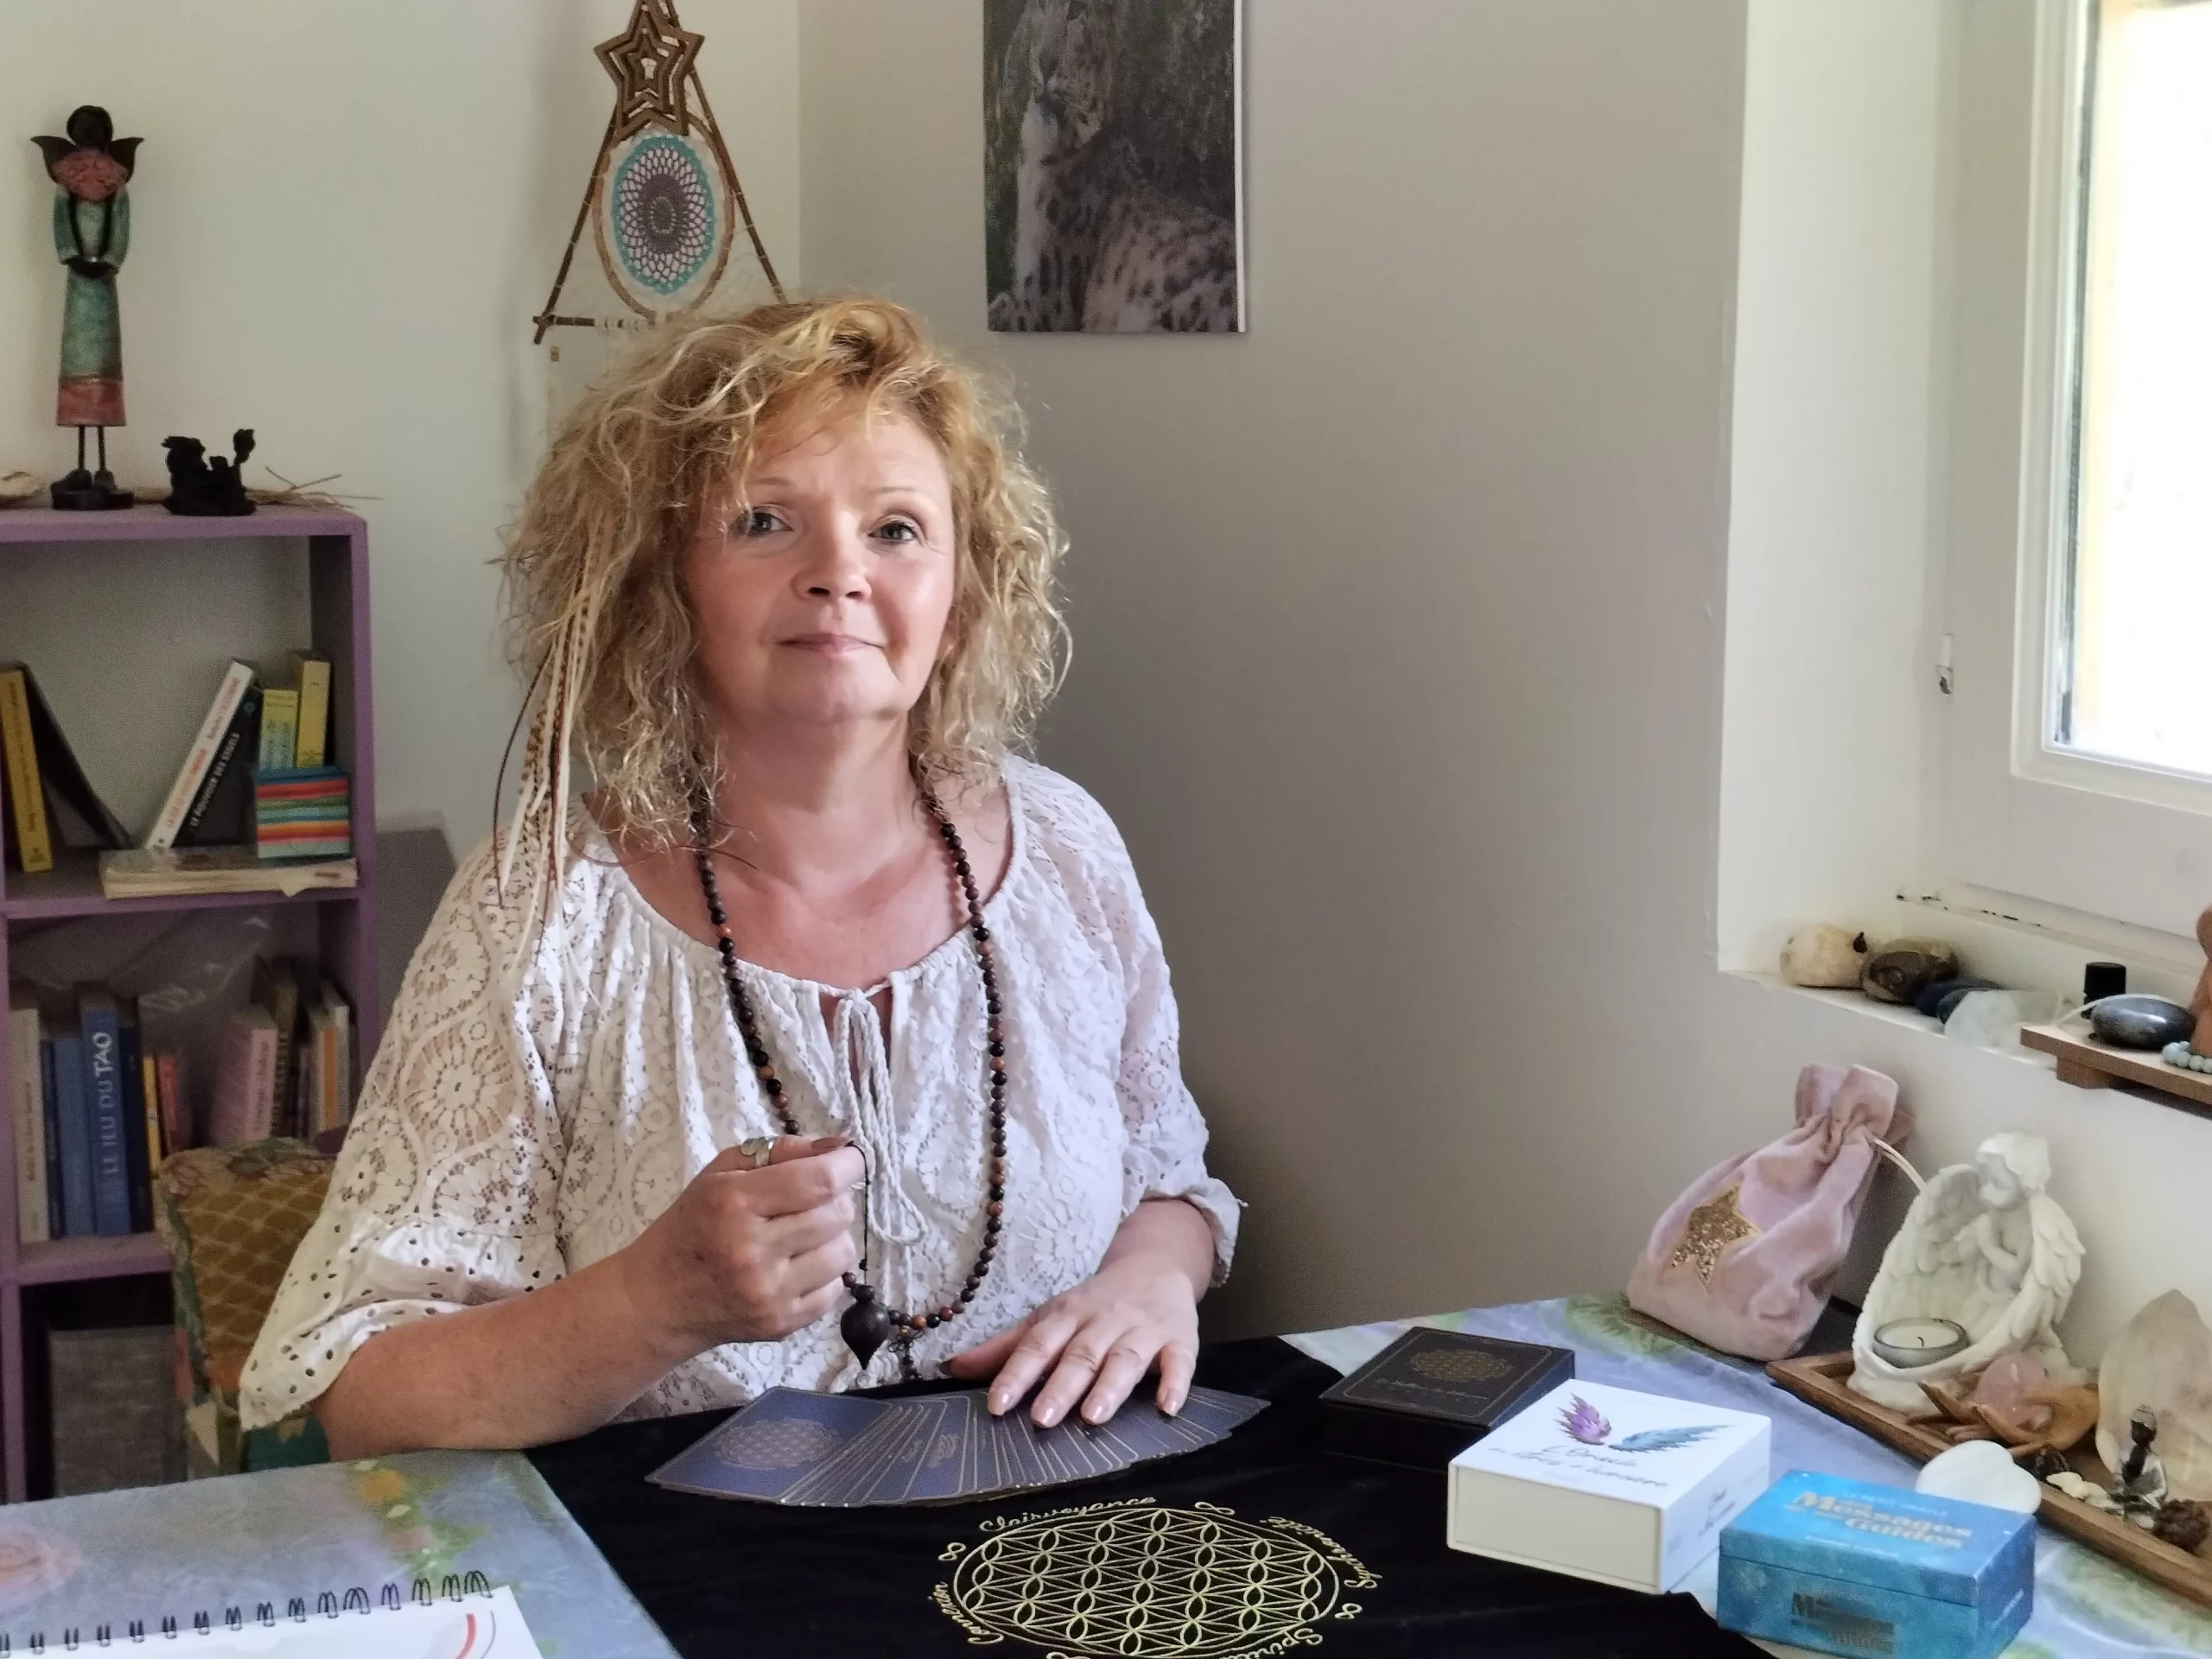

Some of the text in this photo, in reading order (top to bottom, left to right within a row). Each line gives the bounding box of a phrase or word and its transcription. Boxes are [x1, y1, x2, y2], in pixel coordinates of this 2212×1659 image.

[92, 1032, 115, 1077] TAO
[98, 1080, 115, 1109] DU
[978, 1497, 1157, 1532] Clairvoyance
[1787, 1491, 1974, 1538] Messages
[1845, 1517, 1964, 1548] Guides
